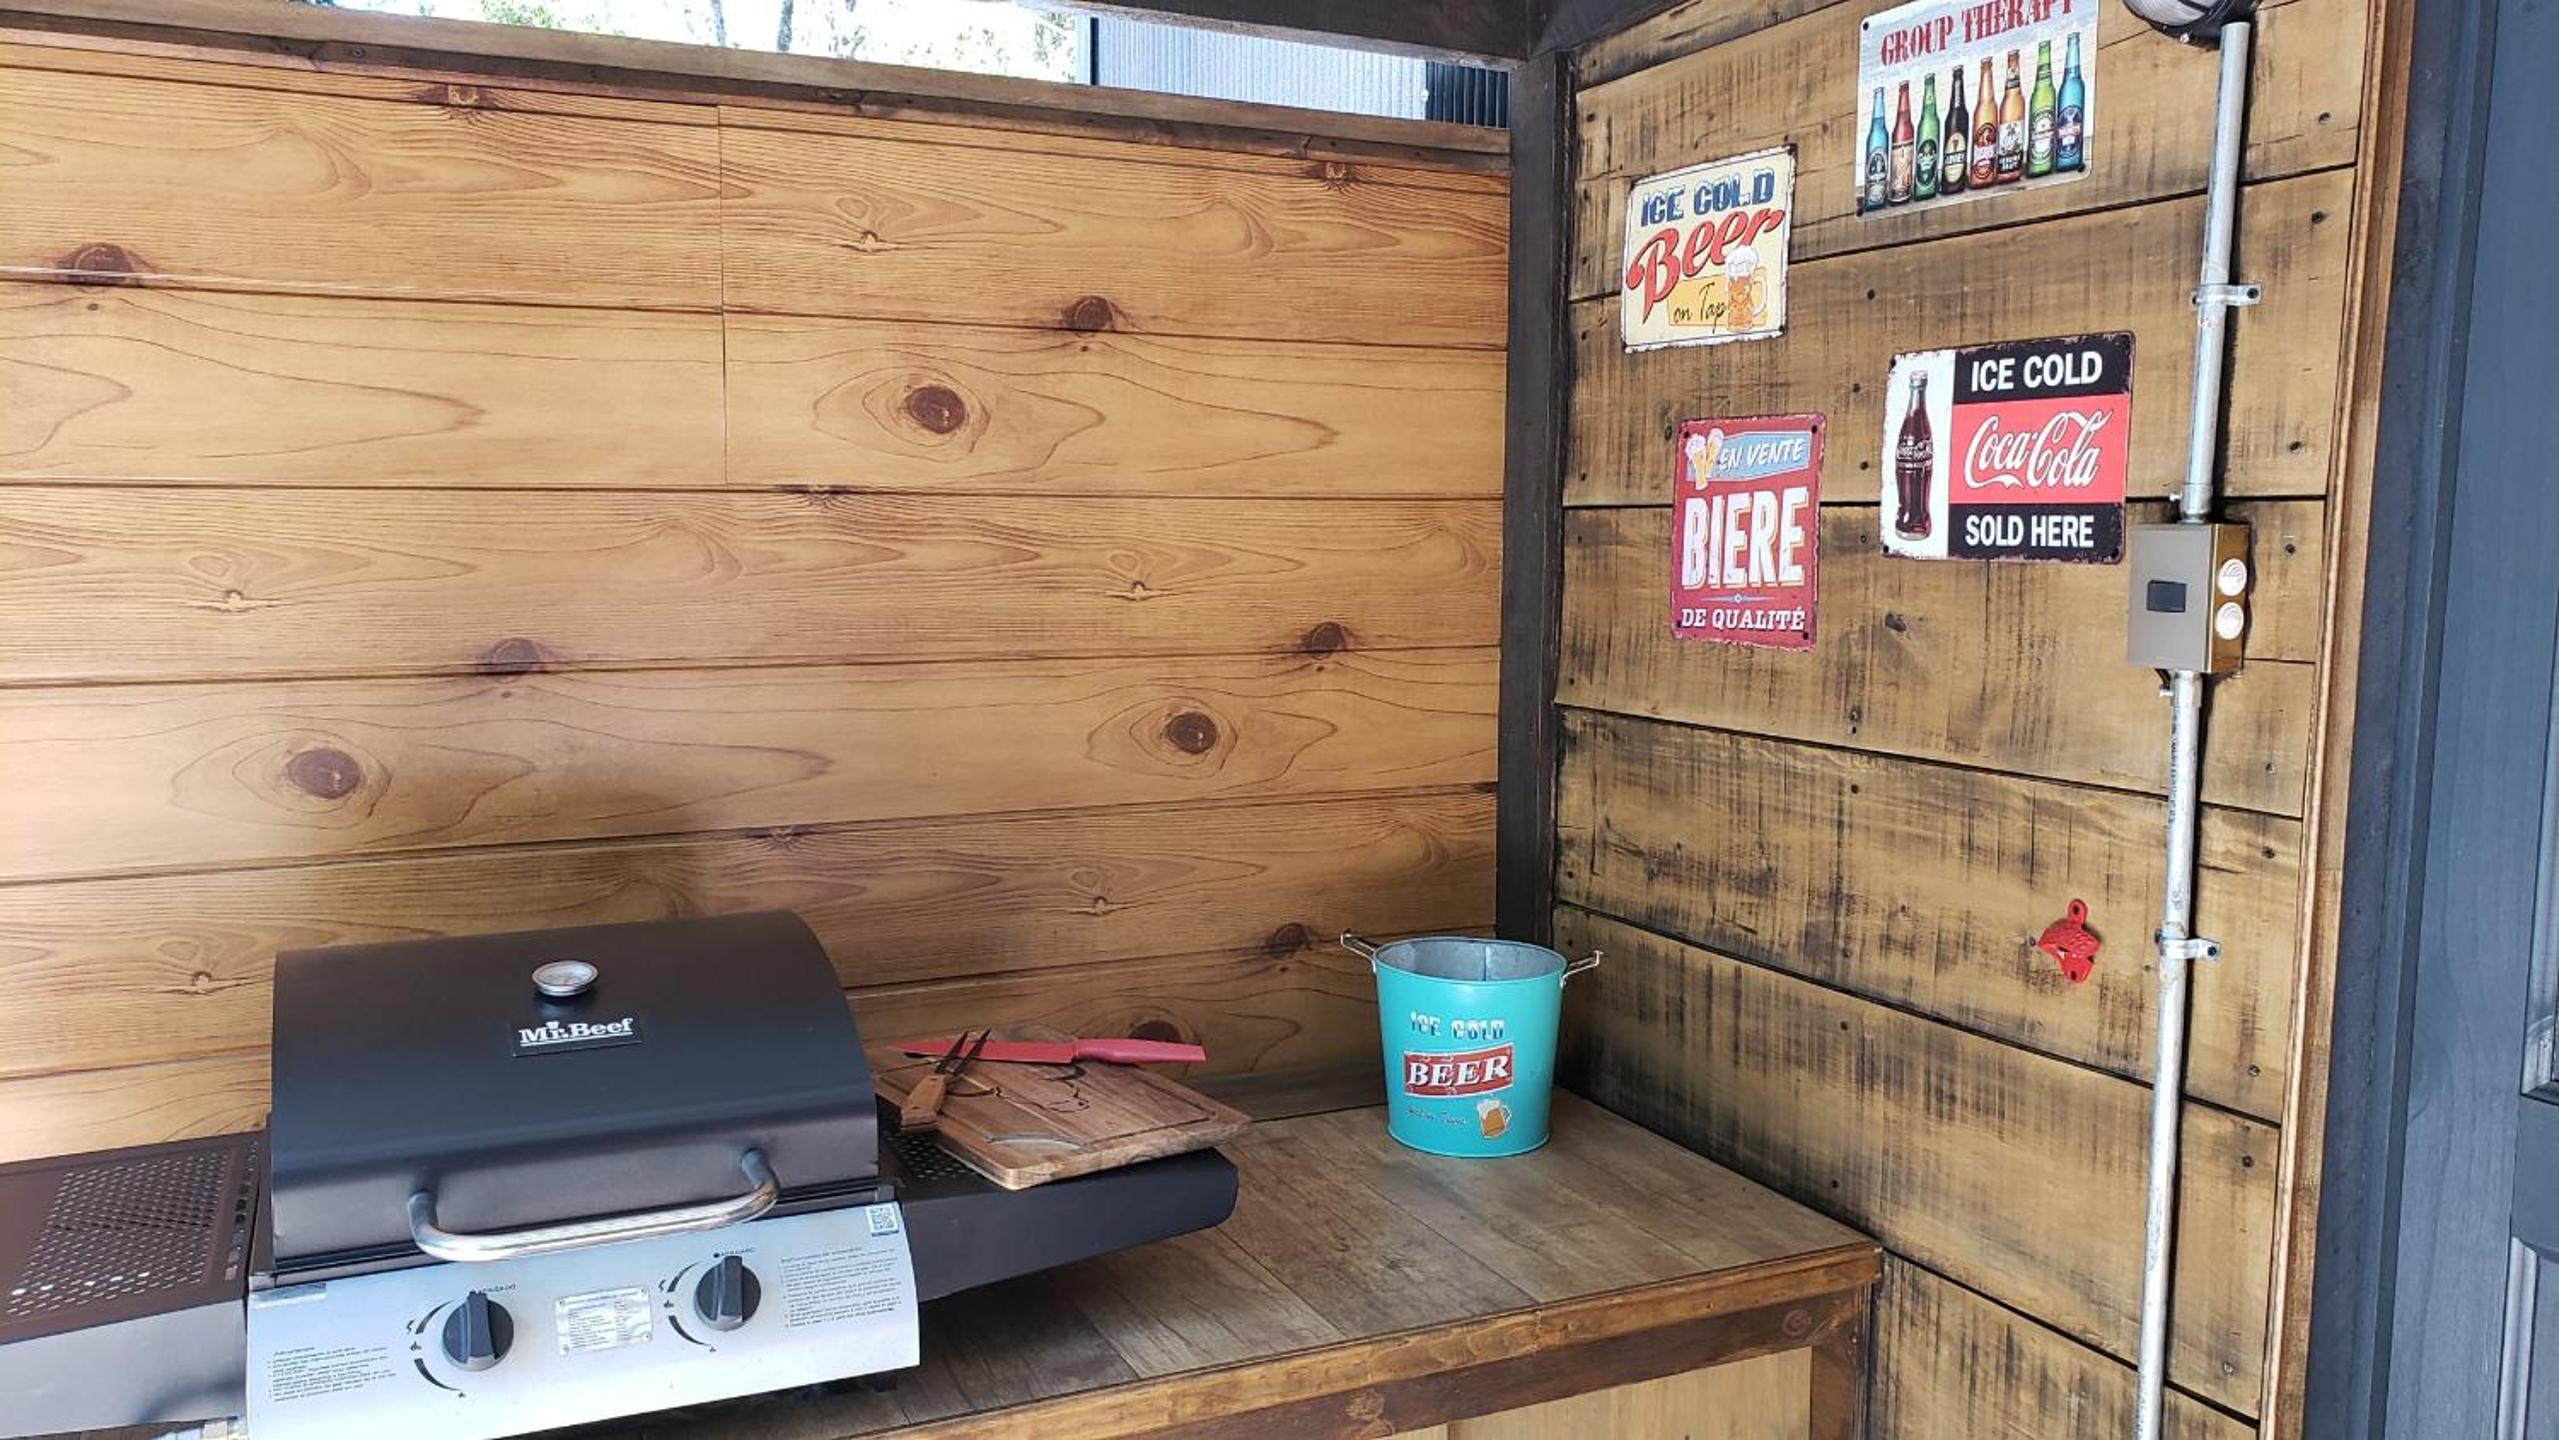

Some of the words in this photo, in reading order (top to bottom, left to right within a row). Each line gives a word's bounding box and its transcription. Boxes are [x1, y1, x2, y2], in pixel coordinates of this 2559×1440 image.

[1880, 15, 1954, 67] GROUP
[1641, 184, 1686, 227] ICE
[1693, 166, 1775, 216] COLD
[1626, 208, 1786, 324] Beer
[1673, 306, 1692, 323] on
[1699, 282, 1728, 334] Tap
[1971, 357, 2016, 392] ICE
[2023, 351, 2103, 388] COLD
[1719, 449, 1743, 471] EN
[1748, 438, 1805, 467] VENTE
[1964, 409, 2114, 489] Coca-Cola
[1681, 487, 1810, 589] BIERE
[1965, 514, 2024, 546] SOLD
[2031, 515, 2095, 547] HERE
[1681, 608, 1708, 628] DE
[1712, 605, 1806, 631] QUALITÉ
[1410, 1011, 1441, 1036] ICE
[1451, 1019, 1504, 1040] COLD
[1407, 1055, 1509, 1087] BEER
